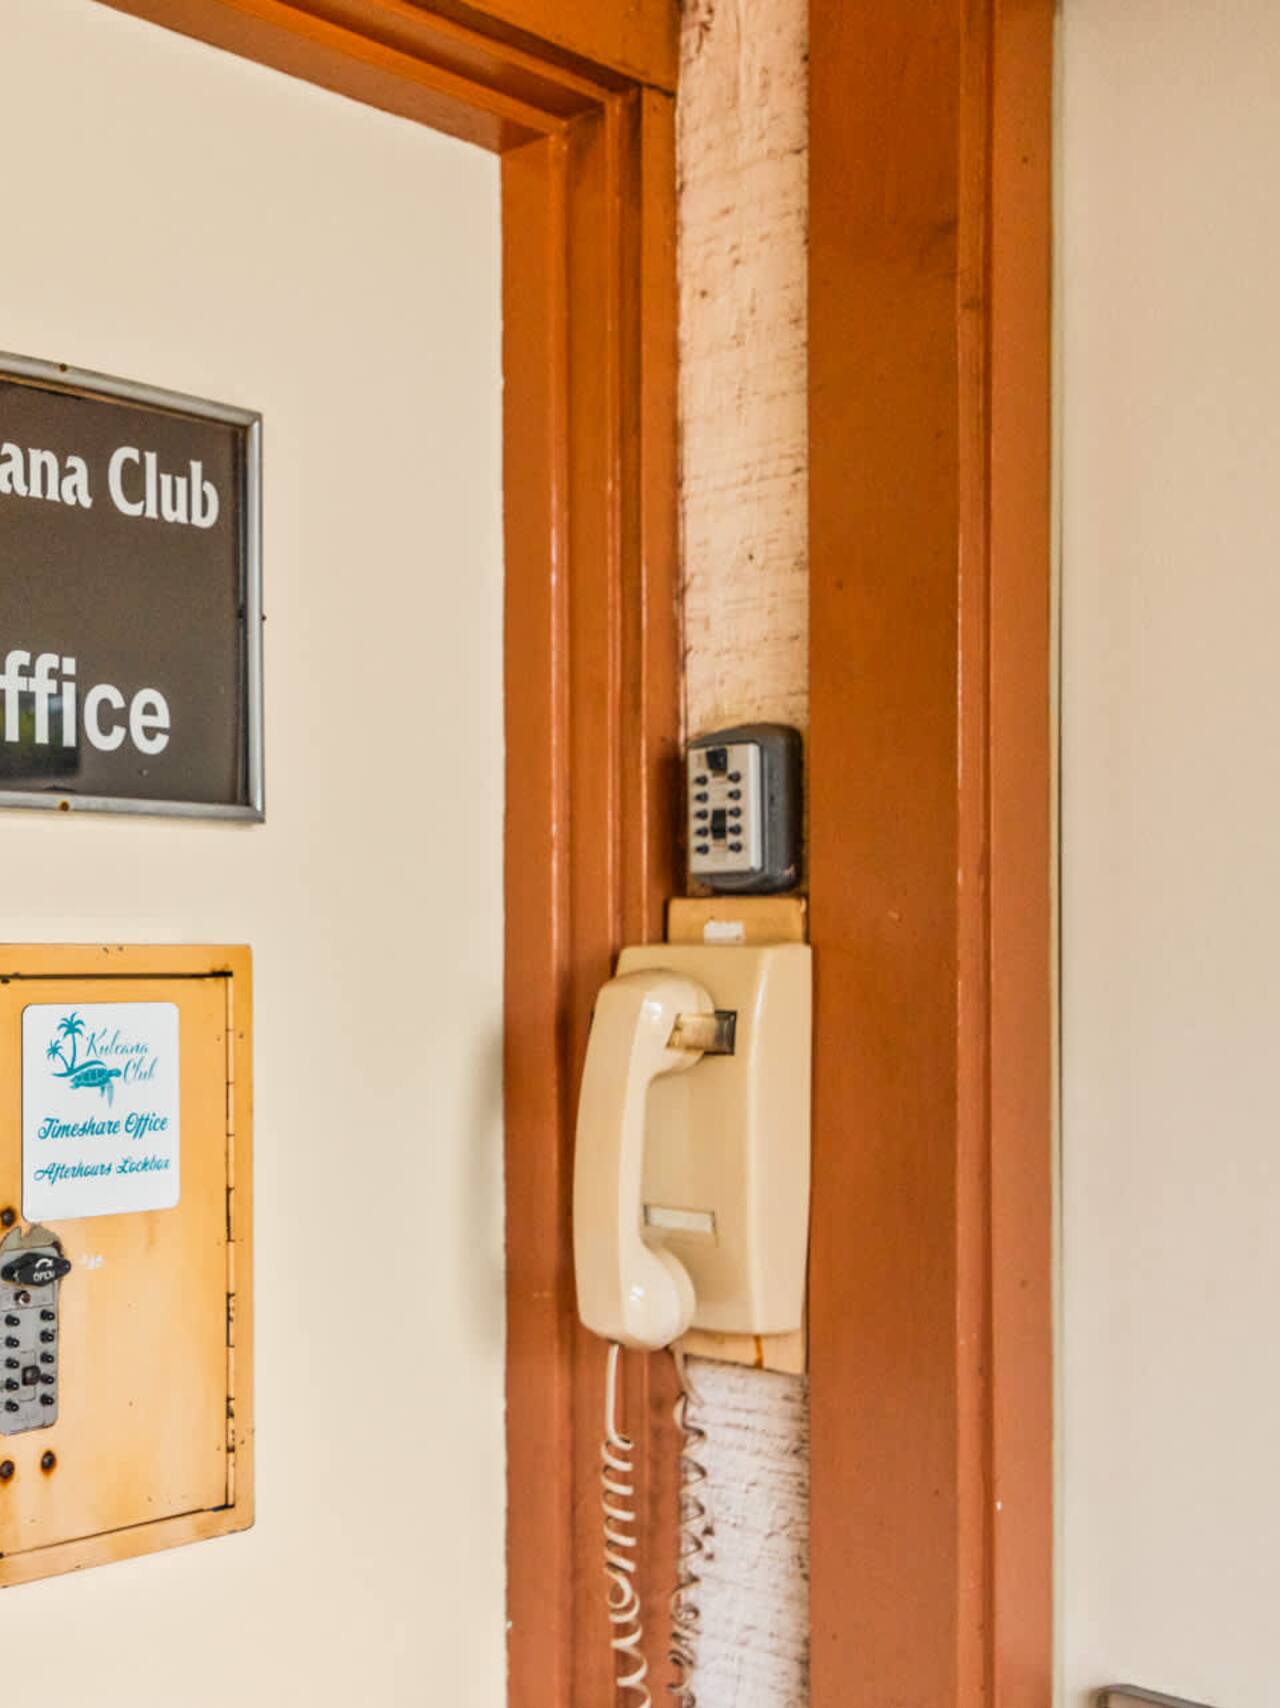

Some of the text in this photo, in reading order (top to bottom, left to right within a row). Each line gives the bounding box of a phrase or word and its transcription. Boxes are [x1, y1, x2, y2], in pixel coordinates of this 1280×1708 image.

[108, 446, 219, 528] Club
[86, 1028, 149, 1057] Kuleana
[123, 1056, 159, 1084] Club
[37, 1111, 170, 1141] Timeshare Office
[33, 1154, 171, 1185] Afterhours Lockbox
[33, 1270, 56, 1282] OPEN
